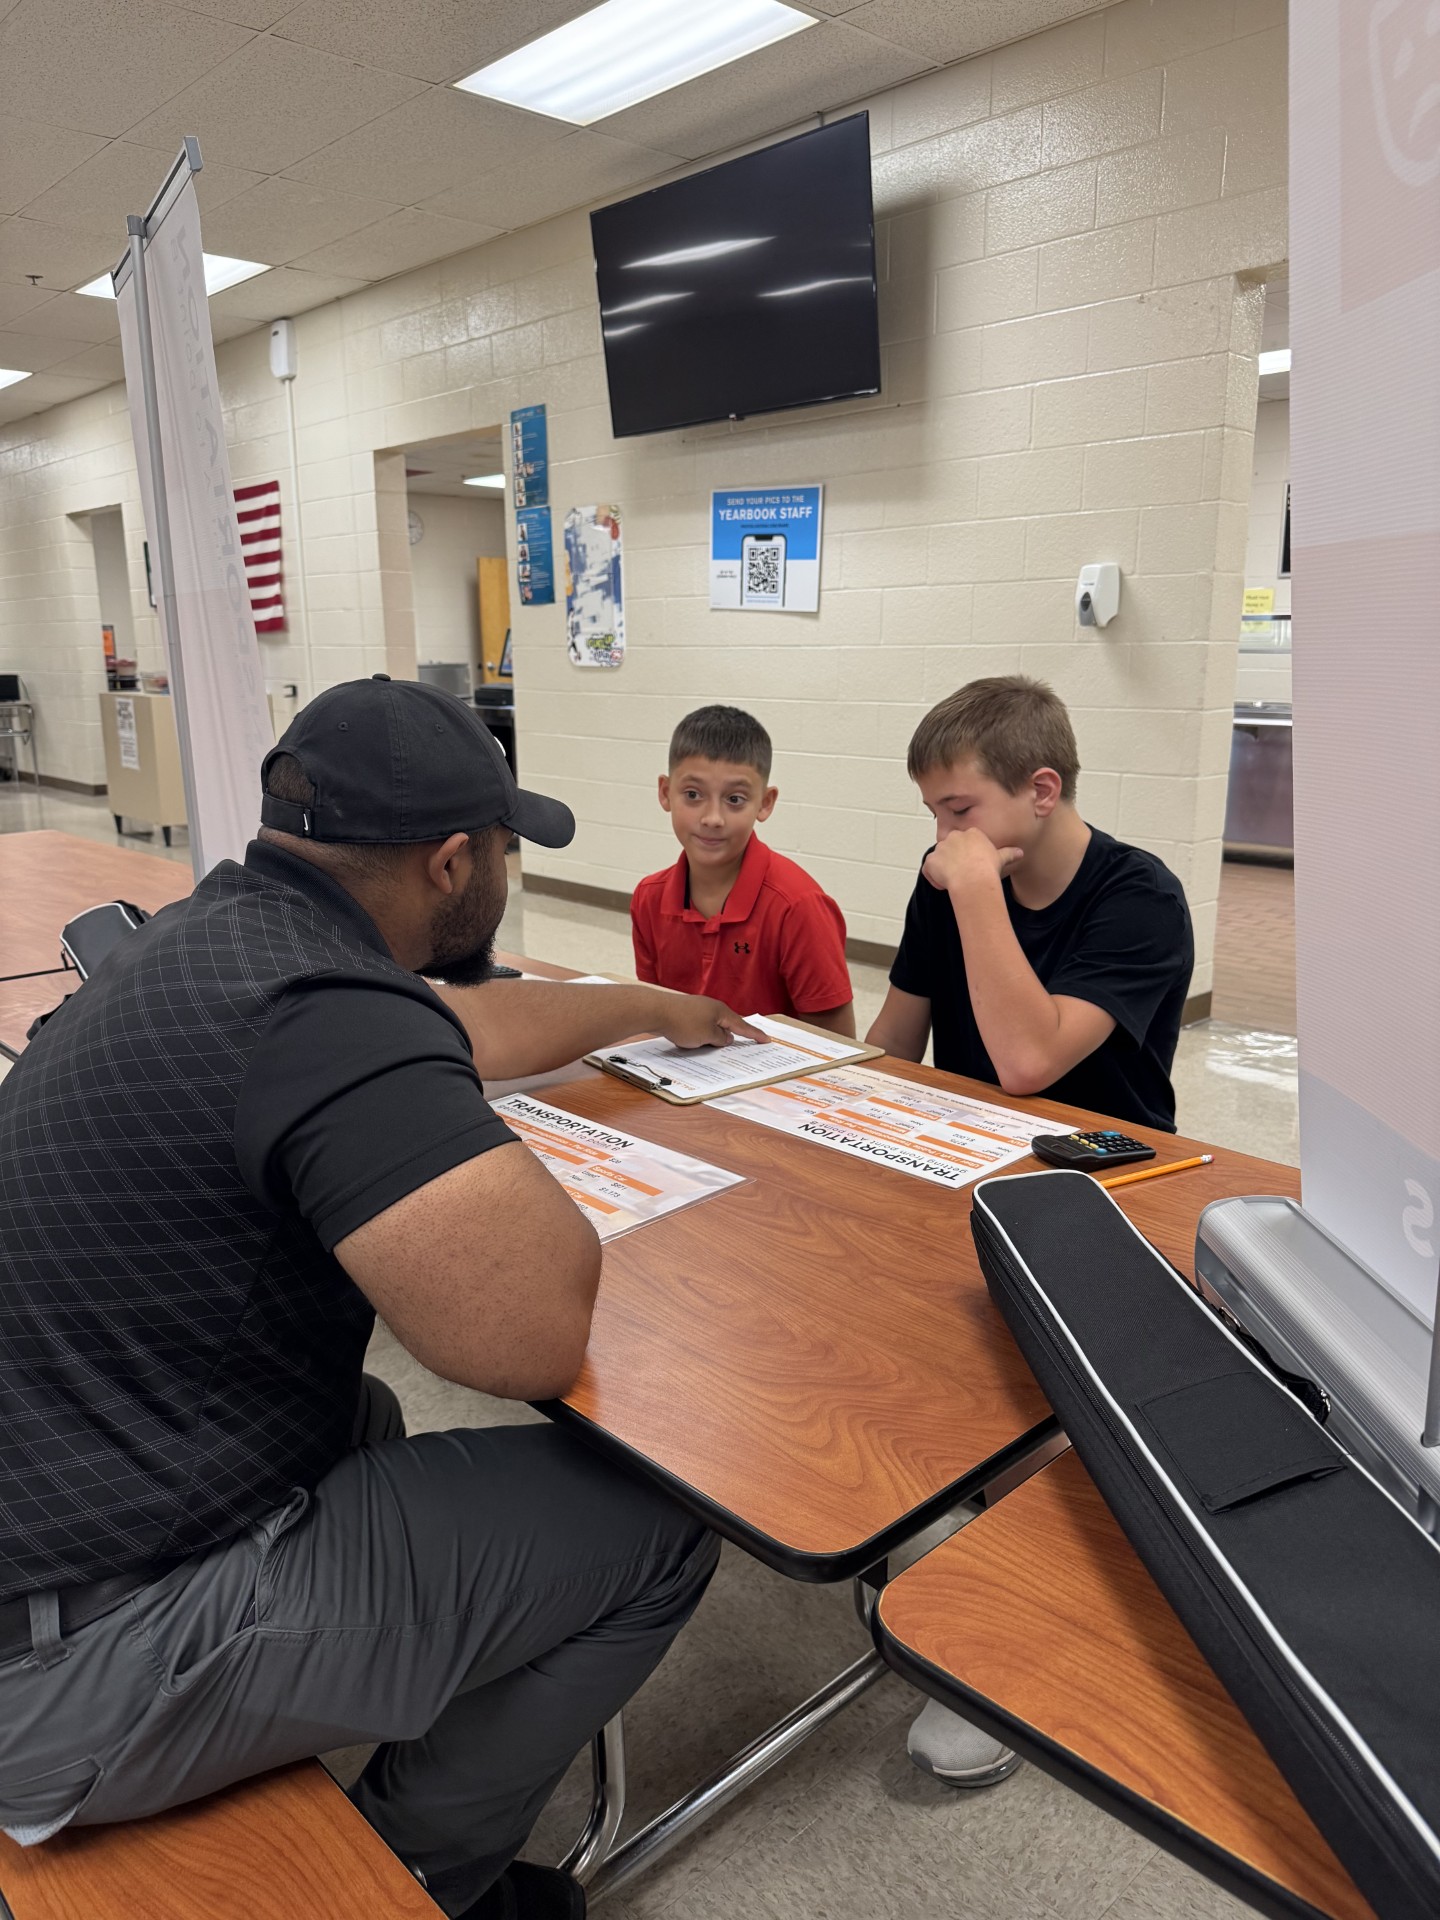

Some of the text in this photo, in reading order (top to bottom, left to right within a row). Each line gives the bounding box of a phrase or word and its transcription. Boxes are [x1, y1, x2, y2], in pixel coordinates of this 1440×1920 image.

[727, 498, 744, 506] SEND
[746, 497, 763, 505] YOUR
[719, 507, 812, 520] YEARBOOK STAFF
[496, 1104, 529, 1116] getting
[525, 1115, 547, 1123] from
[543, 1122, 570, 1132] point
[584, 1138, 612, 1148] point
[504, 1099, 635, 1148] TRANSPORTATION
[816, 1123, 846, 1133] point
[868, 1140, 899, 1151] point
[796, 1123, 963, 1180] TRANSPORTATION
[897, 1150, 925, 1160] from
[969, 1151, 997, 1160] Sedan
[924, 1158, 969, 1174] getting
[957, 1159, 981, 1167] Uber
[590, 1166, 615, 1176] Sports
